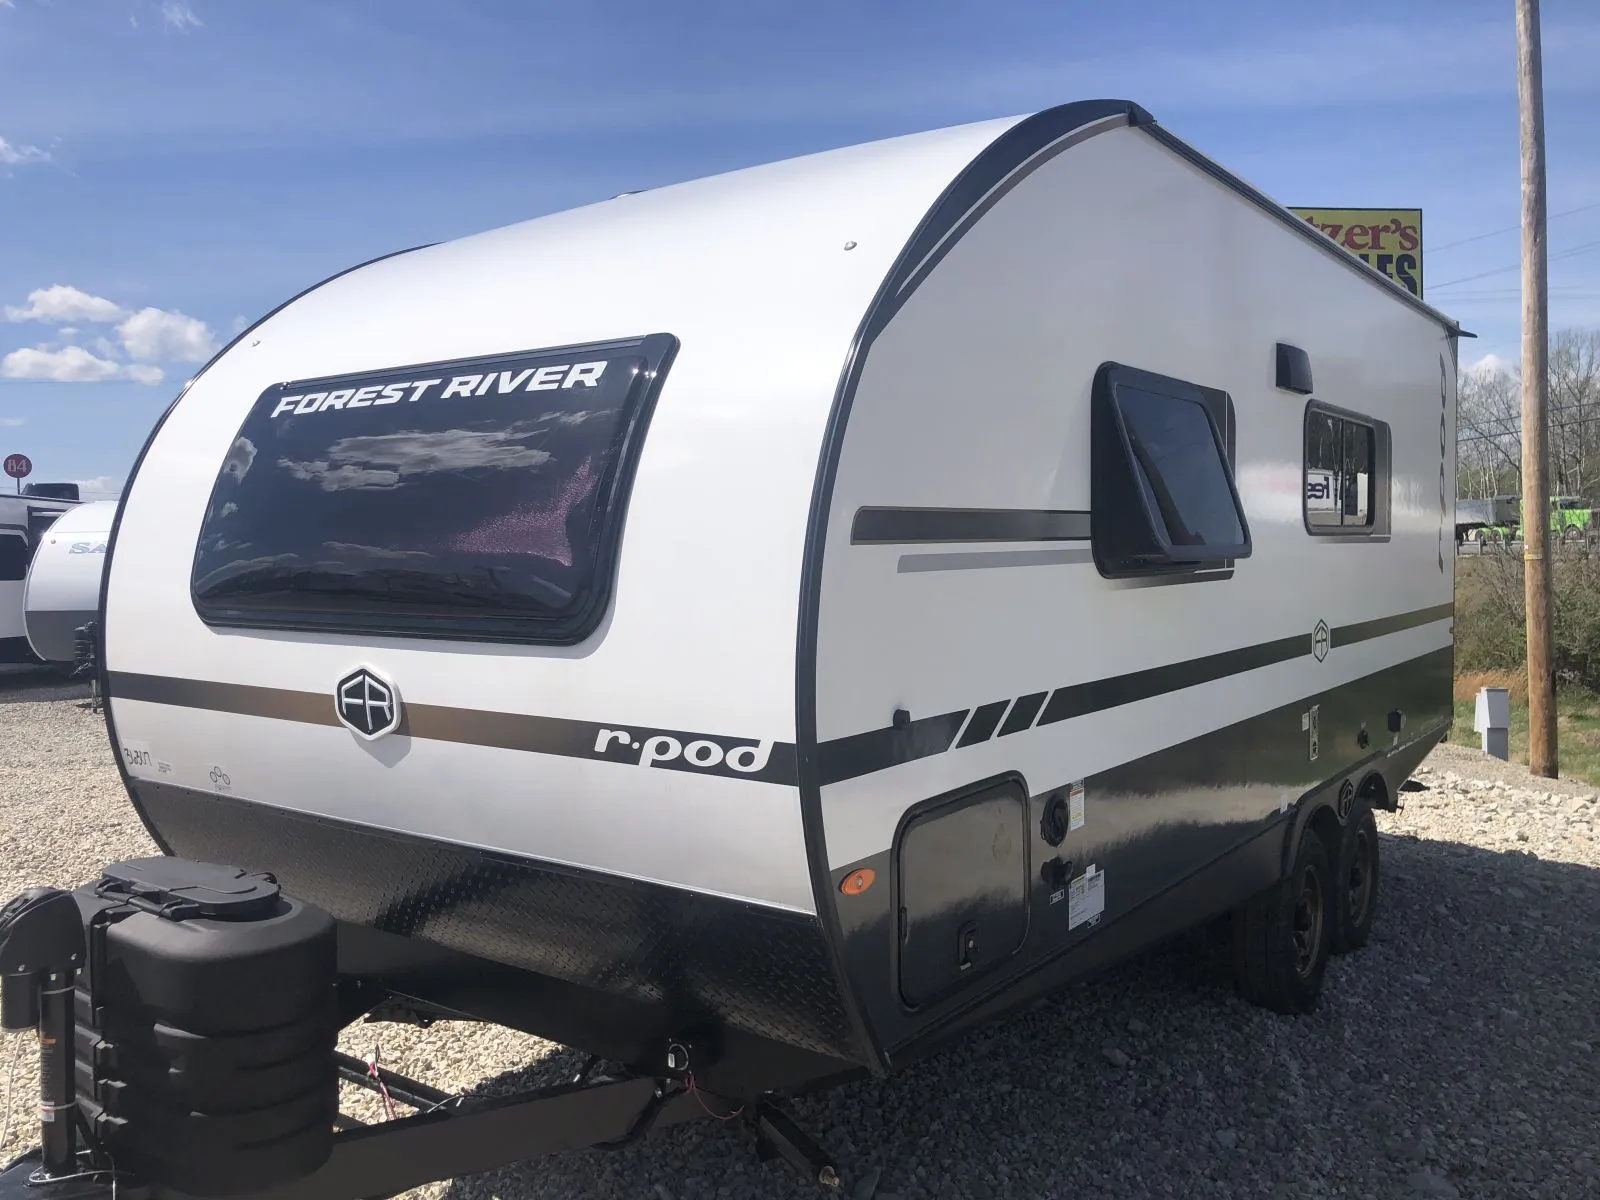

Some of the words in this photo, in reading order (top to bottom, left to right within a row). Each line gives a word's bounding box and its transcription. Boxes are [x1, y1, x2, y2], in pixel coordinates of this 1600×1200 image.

[271, 379, 442, 418] FOREST
[440, 361, 608, 399] RIVER
[7, 459, 27, 472] 84
